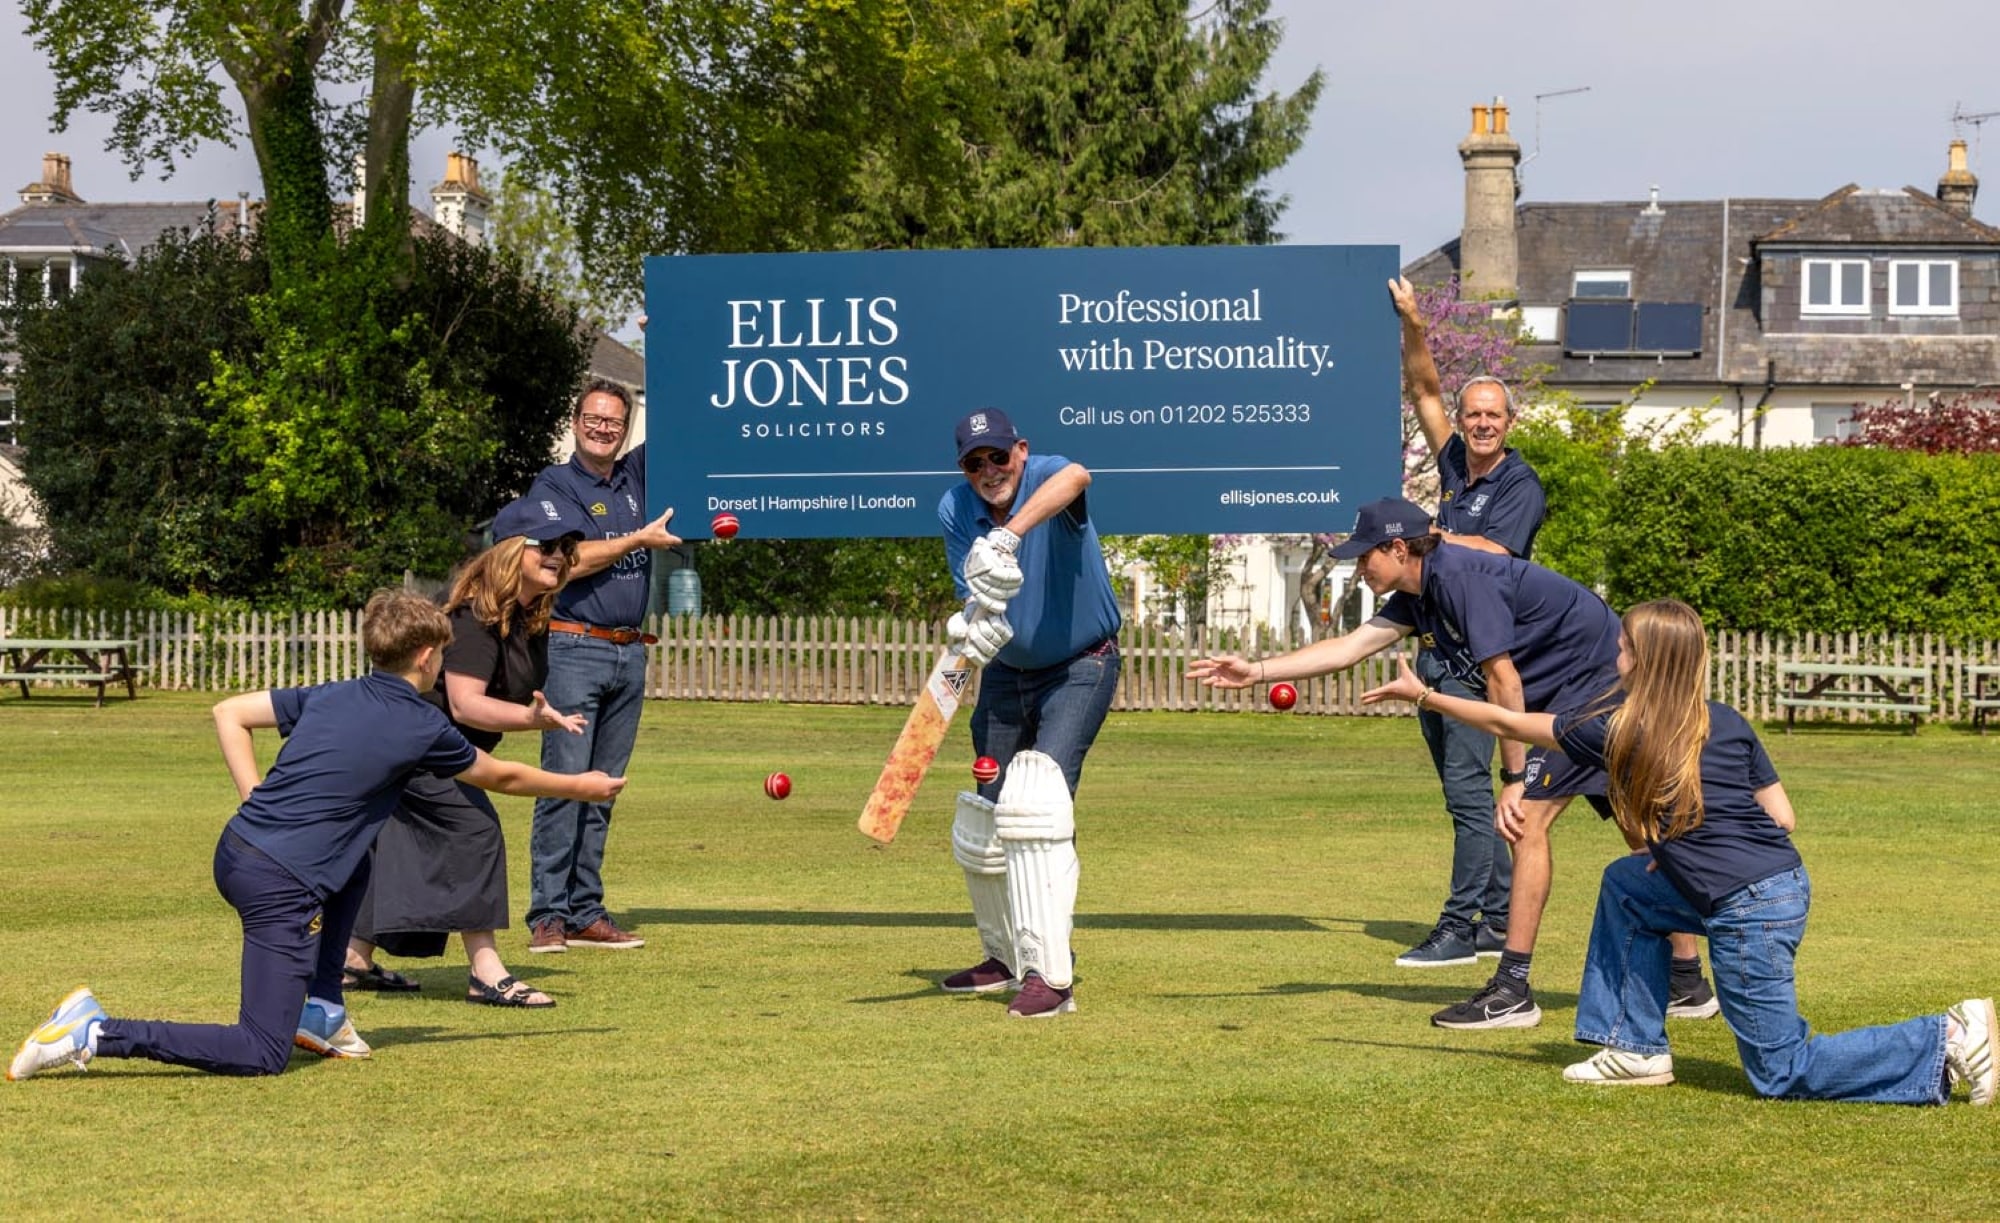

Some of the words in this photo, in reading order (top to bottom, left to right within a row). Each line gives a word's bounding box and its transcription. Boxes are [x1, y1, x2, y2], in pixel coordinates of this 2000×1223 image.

[1058, 287, 1262, 325] Professional
[727, 296, 899, 350] ELLIS
[1058, 337, 1136, 372] with
[1142, 335, 1335, 377] Personality.
[710, 356, 910, 410] JONES
[741, 421, 885, 438] SOLICITORS
[1059, 406, 1096, 426] Call
[1100, 409, 1125, 425] us
[1129, 409, 1155, 425] on
[1160, 404, 1226, 425] 01202
[1232, 403, 1311, 424] 525333
[708, 496, 758, 512] Dorset
[768, 495, 848, 513] Hampshire
[858, 494, 916, 510] London
[1220, 488, 1341, 507] ellisjones.co.uk
